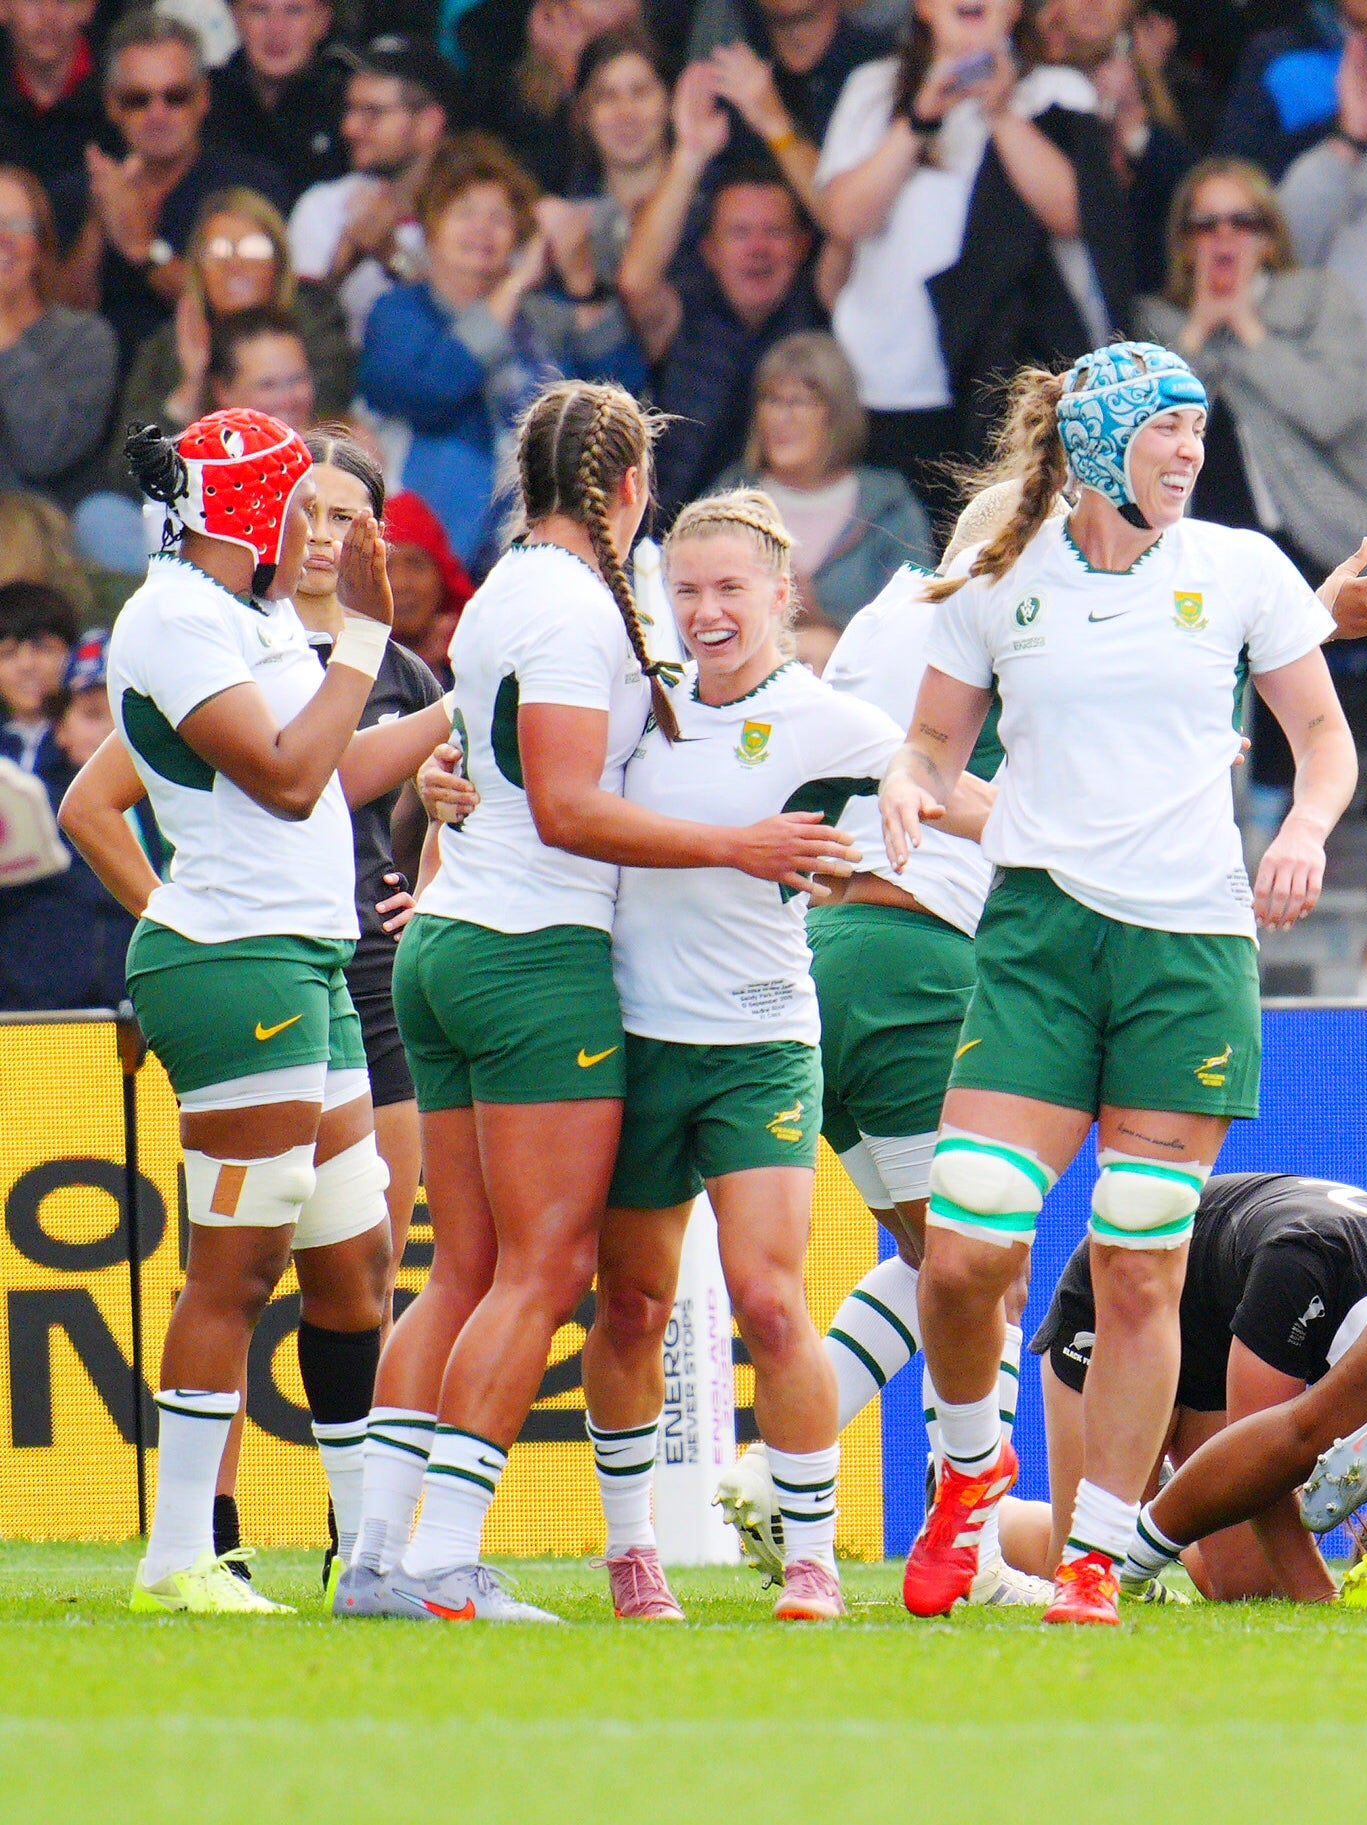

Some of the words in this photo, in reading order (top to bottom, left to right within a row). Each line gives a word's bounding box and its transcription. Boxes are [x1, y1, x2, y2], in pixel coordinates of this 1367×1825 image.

[664, 1302, 684, 1465] ENERG
[682, 1299, 697, 1375] STOPS
[707, 1286, 722, 1465] ENGLAND
[685, 1383, 699, 1464] NEVER
